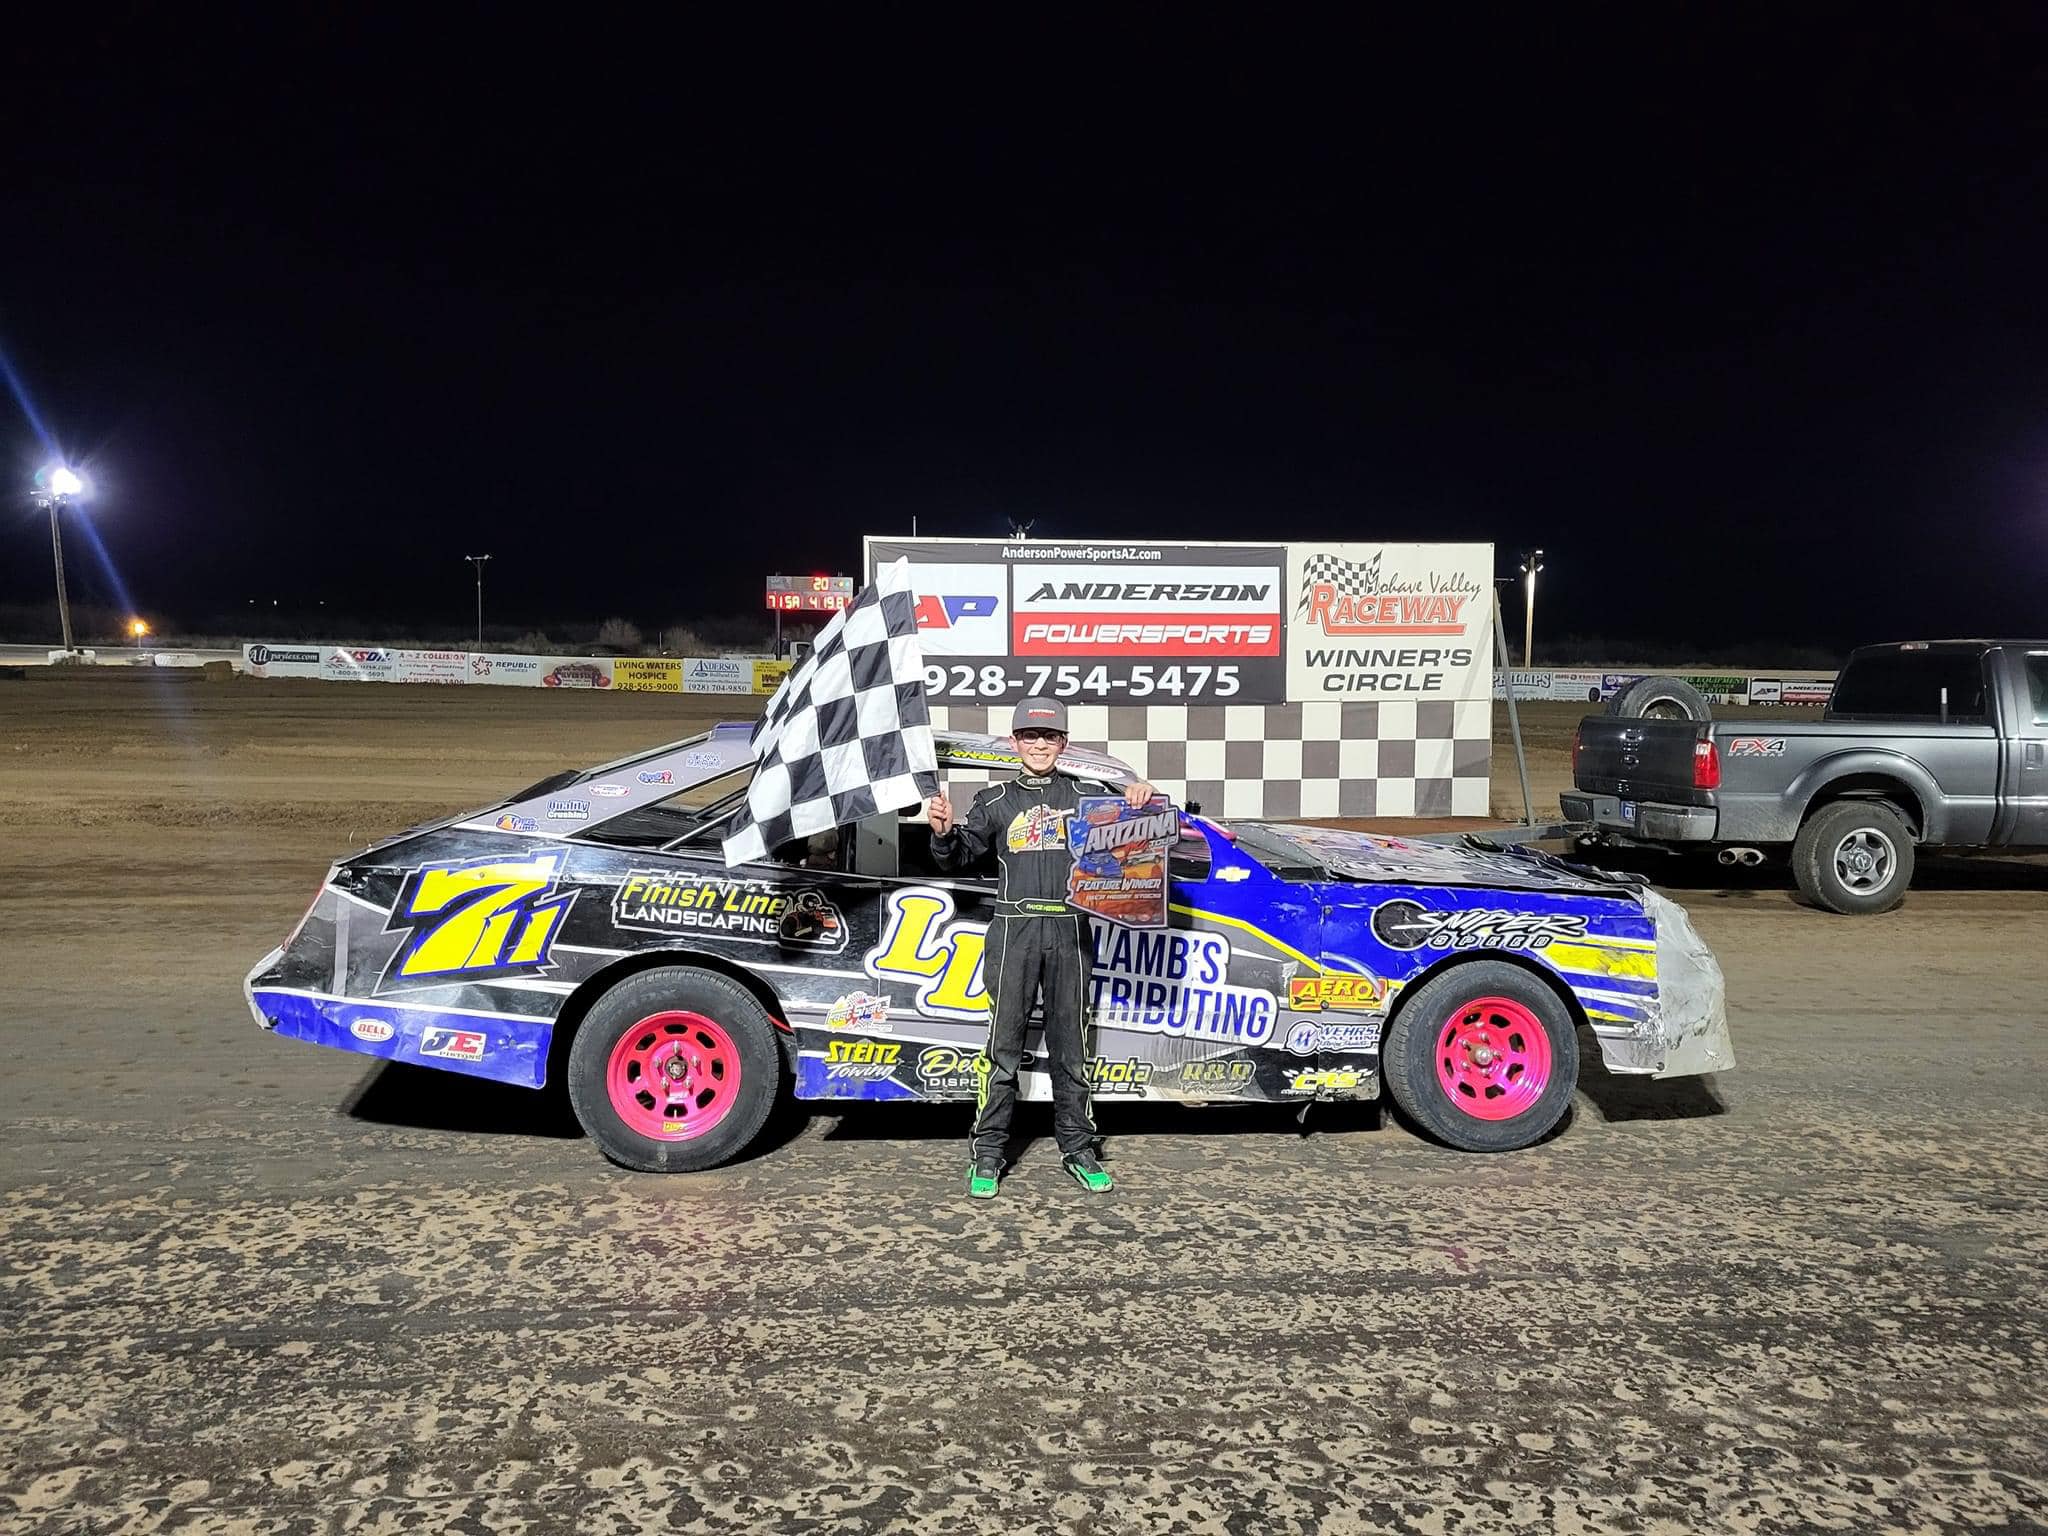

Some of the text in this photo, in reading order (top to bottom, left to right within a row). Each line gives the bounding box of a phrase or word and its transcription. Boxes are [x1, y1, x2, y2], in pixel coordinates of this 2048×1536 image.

[1002, 546, 1161, 561] AndersonPowerSportsAZ.com
[813, 577, 829, 591] 20
[1025, 582, 1271, 603] ANDERSON
[1362, 568, 1482, 602] Mohave Valley
[915, 595, 999, 627] AP
[1306, 583, 1467, 632] RACEWAY
[1023, 624, 1272, 645] POWERSPORTS
[614, 661, 645, 669] LIVING
[690, 660, 739, 676] ANDERSON
[1305, 649, 1473, 668] WINNER'S
[628, 672, 667, 680] HOSPICE
[923, 665, 1241, 697] 928-754-5475
[1323, 673, 1443, 692] CIRCLE
[617, 683, 679, 691] 928-565-9000
[712, 684, 747, 692] 704-9850
[1729, 738, 1786, 753] FX4
[1085, 811, 1176, 854] ARIZONA
[1077, 879, 1162, 892] FEATURE WINNER
[622, 876, 788, 915] Finish Line
[620, 903, 781, 935] LANDSCAPING
[1391, 911, 1587, 937] SNIPER
[1433, 934, 1553, 948] SPEED
[1093, 925, 1221, 985] LAMB'S
[1299, 980, 1373, 998] AERO
[1090, 974, 1270, 1039] TRIBUTING
[358, 1024, 387, 1035] BELL
[1321, 1027, 1377, 1036] WEHRS
[421, 1031, 482, 1054] JE
[825, 1042, 901, 1063] STEITZ
[828, 1063, 897, 1081] Towing
